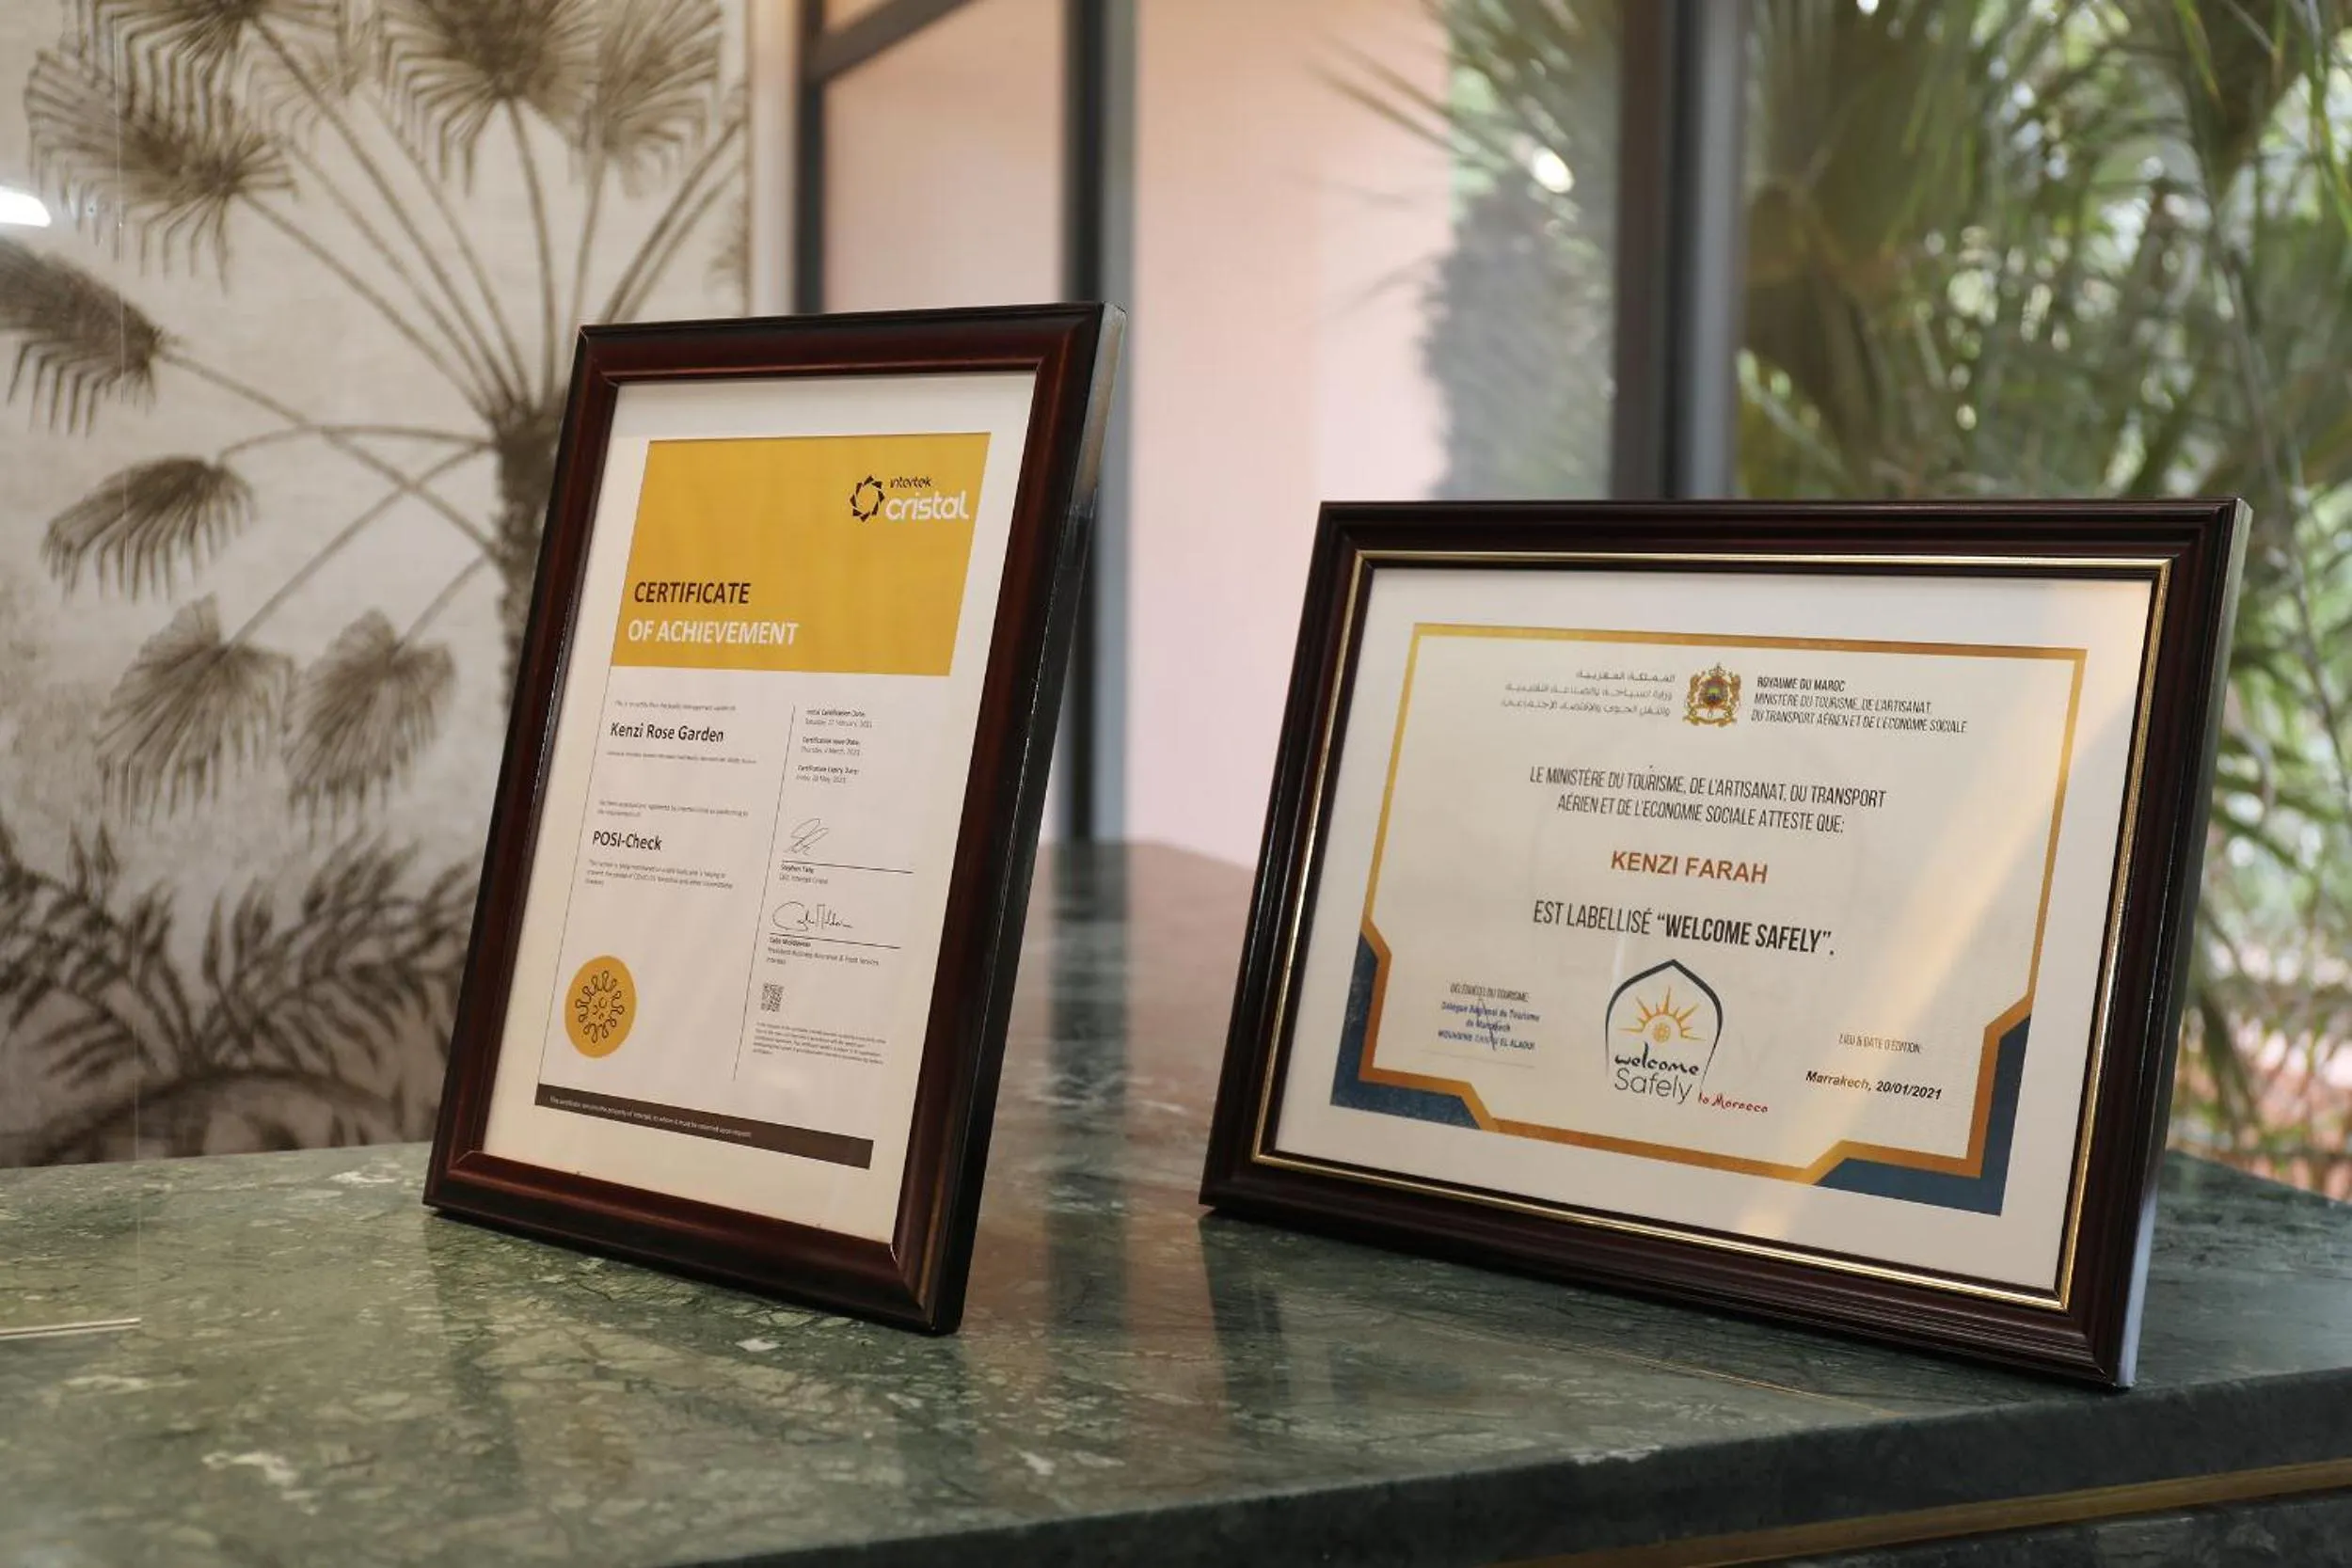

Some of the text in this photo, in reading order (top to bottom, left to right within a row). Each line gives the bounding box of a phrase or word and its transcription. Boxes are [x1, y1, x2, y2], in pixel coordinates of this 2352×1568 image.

[889, 475, 932, 489] intertek
[885, 490, 970, 522] cristal
[634, 580, 752, 605] CERTIFICATE
[628, 619, 800, 646] OF ACHIEVEMENT
[1756, 676, 1846, 692] ROYAUME DU MAROC
[1800, 695, 1813, 707] DU
[1862, 699, 1875, 711] DE
[610, 721, 724, 743] Kenzi Rose Garden
[1751, 709, 1764, 722] DU
[1765, 709, 1816, 724] TRANSPORT
[1863, 716, 1876, 729] DE
[1929, 719, 1968, 734] SOCIALE
[1529, 766, 1545, 784] LE
[1608, 771, 1625, 790] DU
[1627, 772, 1687, 795] TOURISME,
[1690, 777, 1706, 796] DE
[1789, 784, 1807, 802] DU
[1811, 784, 1887, 809] TRANSPORT
[1557, 793, 1598, 814] AÉRIEN
[1600, 797, 1616, 815] ET
[1617, 800, 1633, 816] DE
[1706, 805, 1757, 827] SOCIALE
[1757, 809, 1814, 832] ATTESTE
[1816, 813, 1845, 834] QUE:
[592, 830, 663, 851] POSI-Check
[1610, 849, 1769, 885] KENZI FARAH
[1532, 899, 1565, 925] EST
[1565, 903, 1653, 936] LABELLISÉ
[1614, 1040, 1700, 1076] welcome
[1614, 1067, 1693, 1105] Safely
[1805, 1070, 1943, 1101] Marrakech, 20/01/2021
[1711, 1092, 1769, 1114] Morocco
